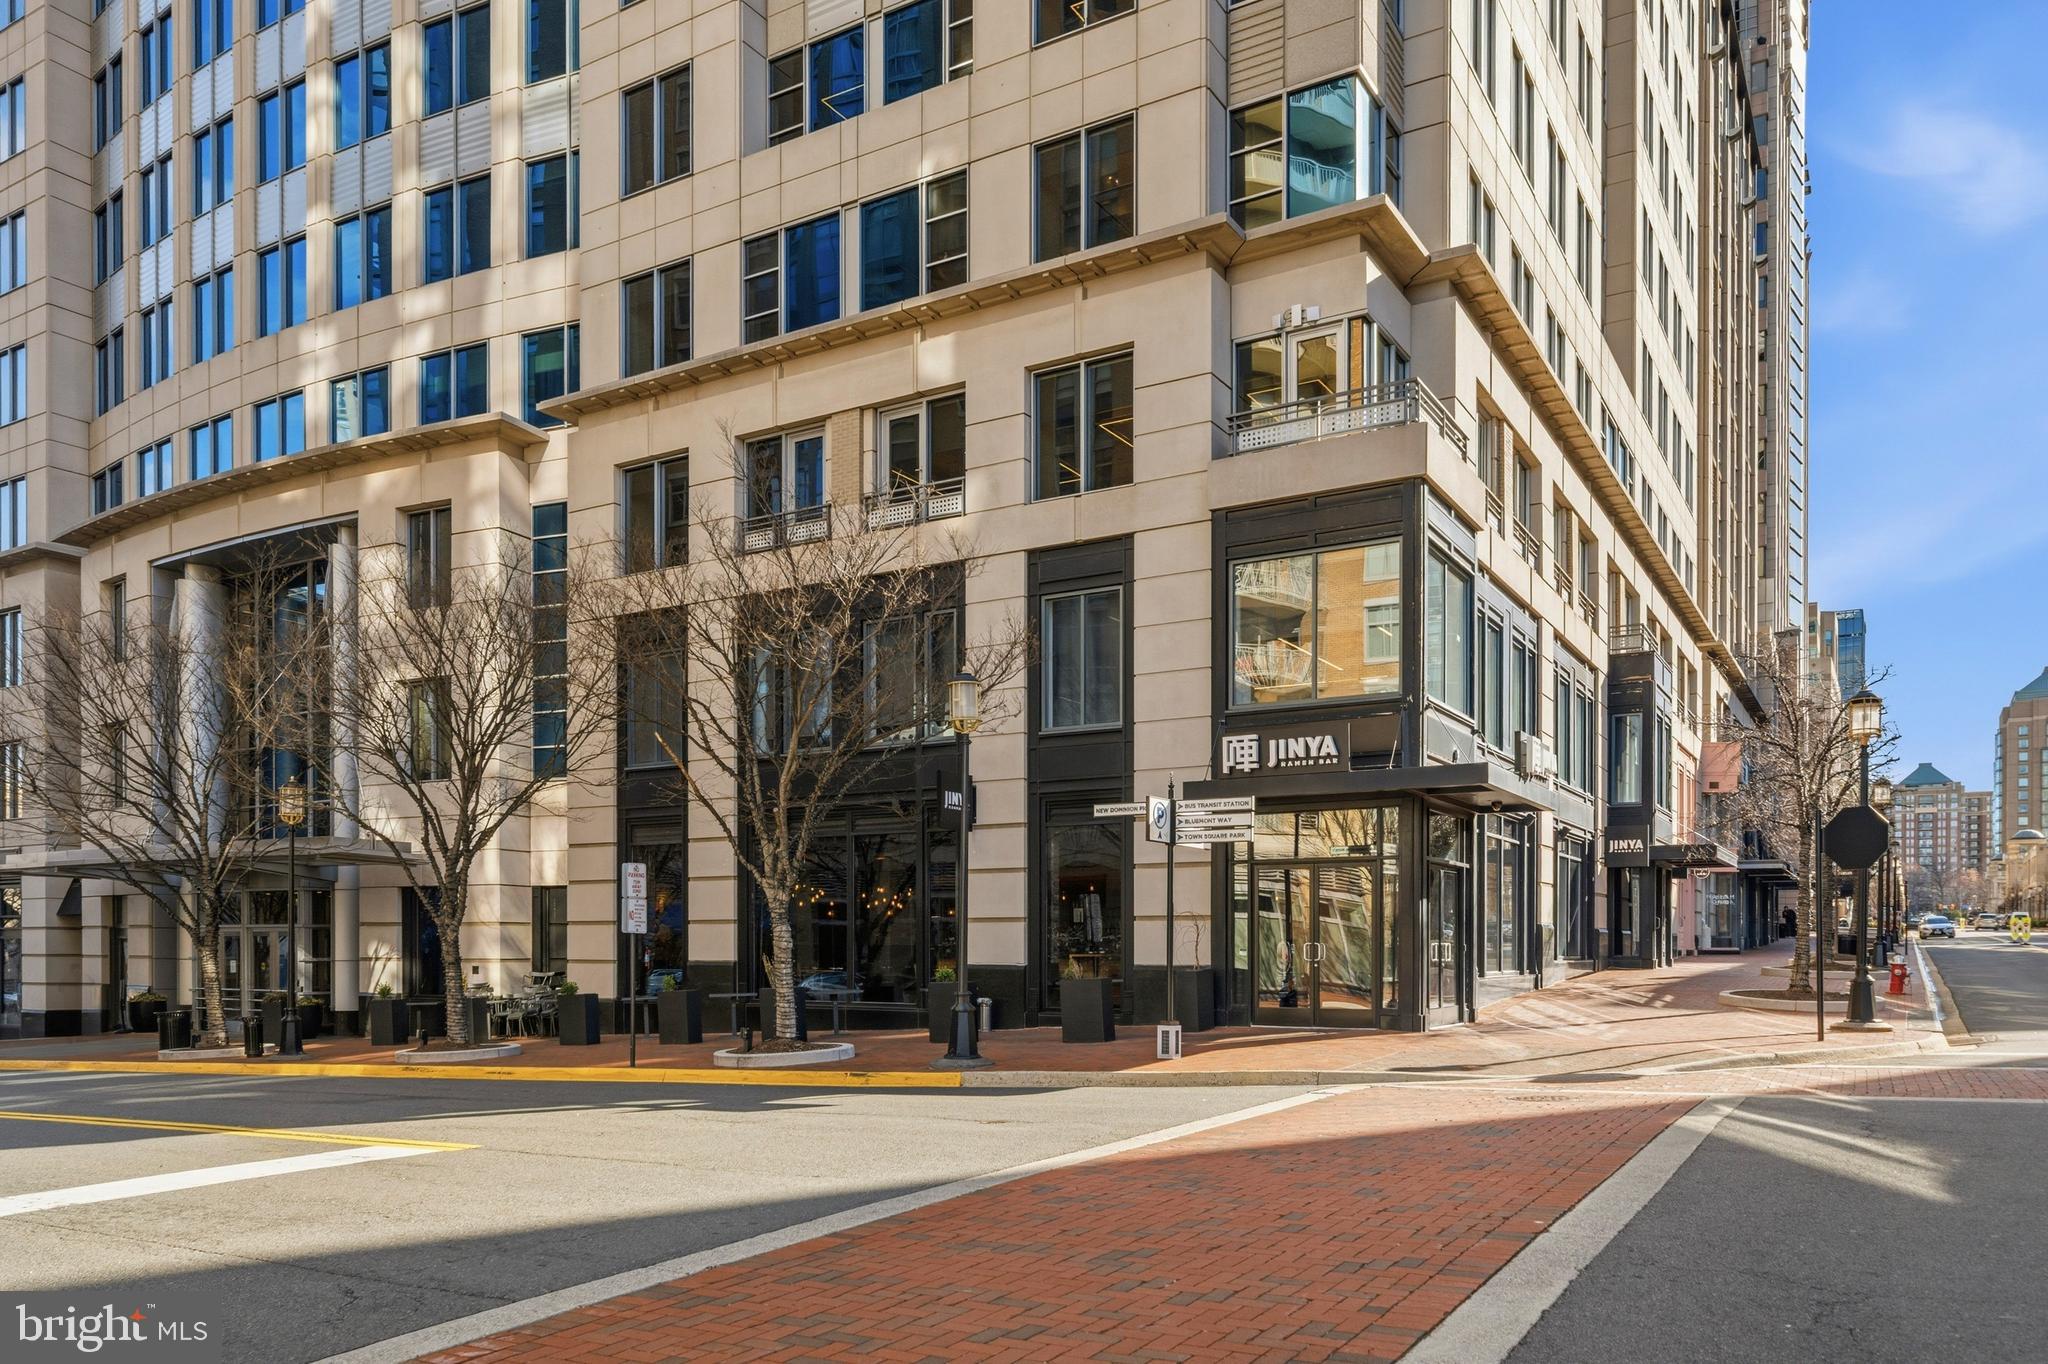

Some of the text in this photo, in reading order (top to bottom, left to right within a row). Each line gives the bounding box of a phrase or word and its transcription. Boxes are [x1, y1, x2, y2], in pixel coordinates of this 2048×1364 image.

[1267, 735, 1339, 768] JINYA
[944, 790, 963, 808] JIN
[1609, 839, 1643, 853] JINYA
